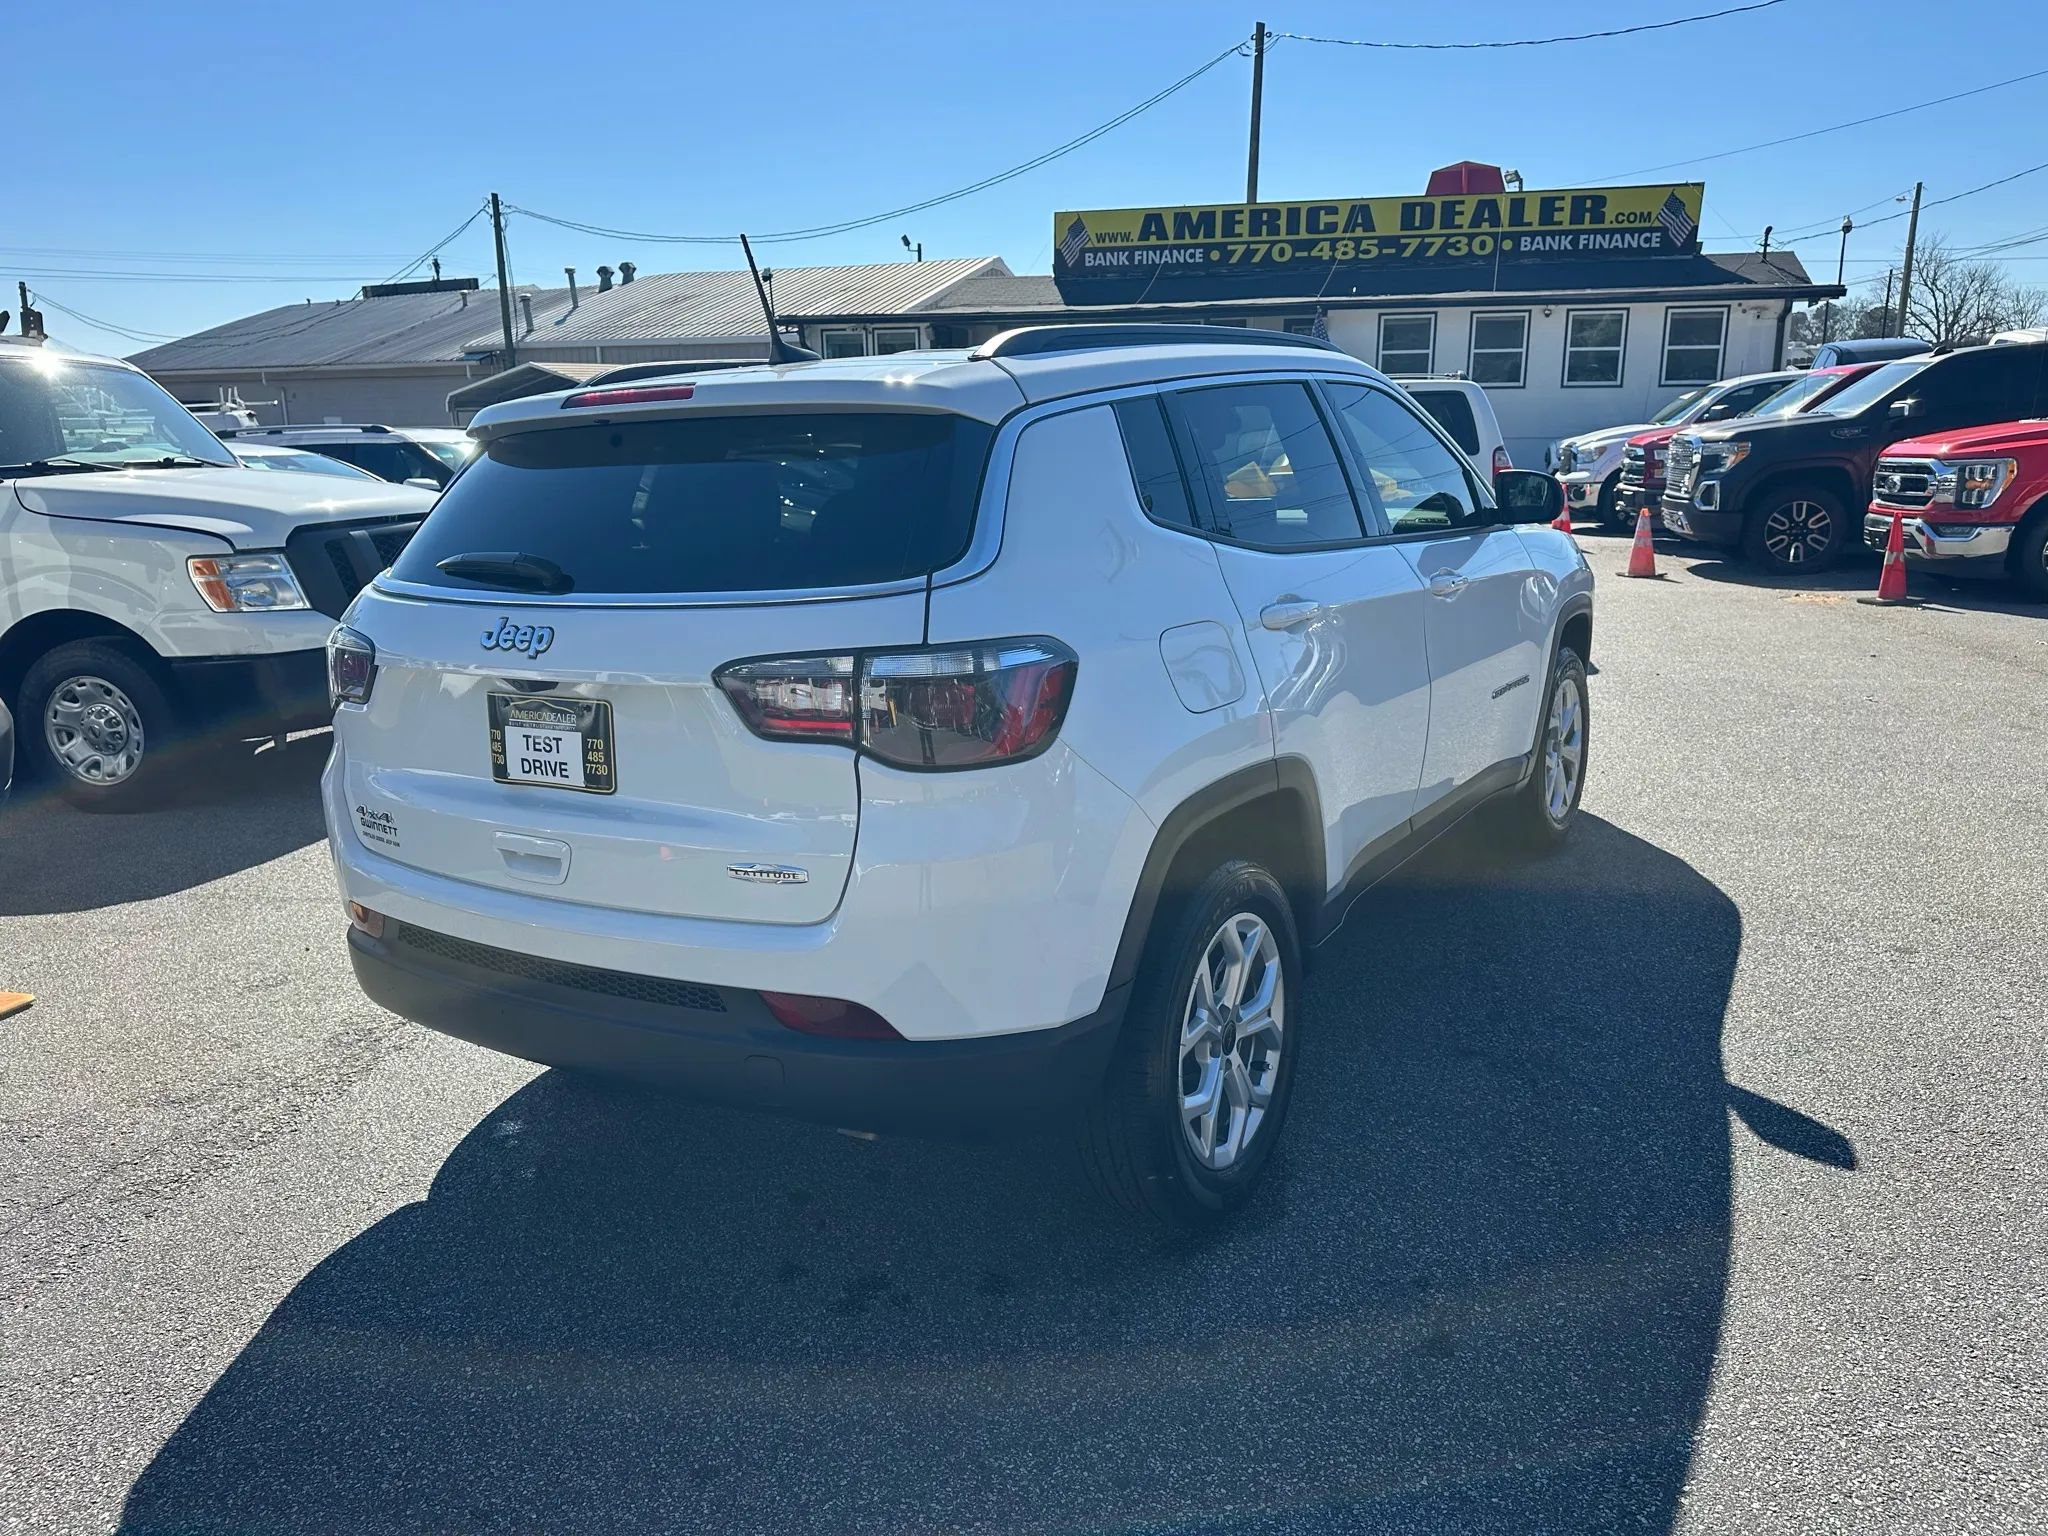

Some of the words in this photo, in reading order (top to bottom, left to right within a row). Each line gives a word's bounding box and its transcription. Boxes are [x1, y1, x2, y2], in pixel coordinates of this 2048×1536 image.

[1084, 251, 1132, 267] BANK
[1134, 248, 1204, 265] FINANCE
[1226, 234, 1495, 265] 770-485-7730
[1519, 234, 1574, 252] BANK
[1578, 231, 1661, 250] FINANCE
[480, 616, 555, 660] Jeep
[490, 728, 501, 740] 770
[522, 734, 562, 754] TEST
[587, 738, 604, 750] 770
[587, 751, 605, 763] 485
[520, 757, 570, 779] DRIVE
[586, 763, 608, 775] 7730
[734, 869, 800, 880] LATITUDE
